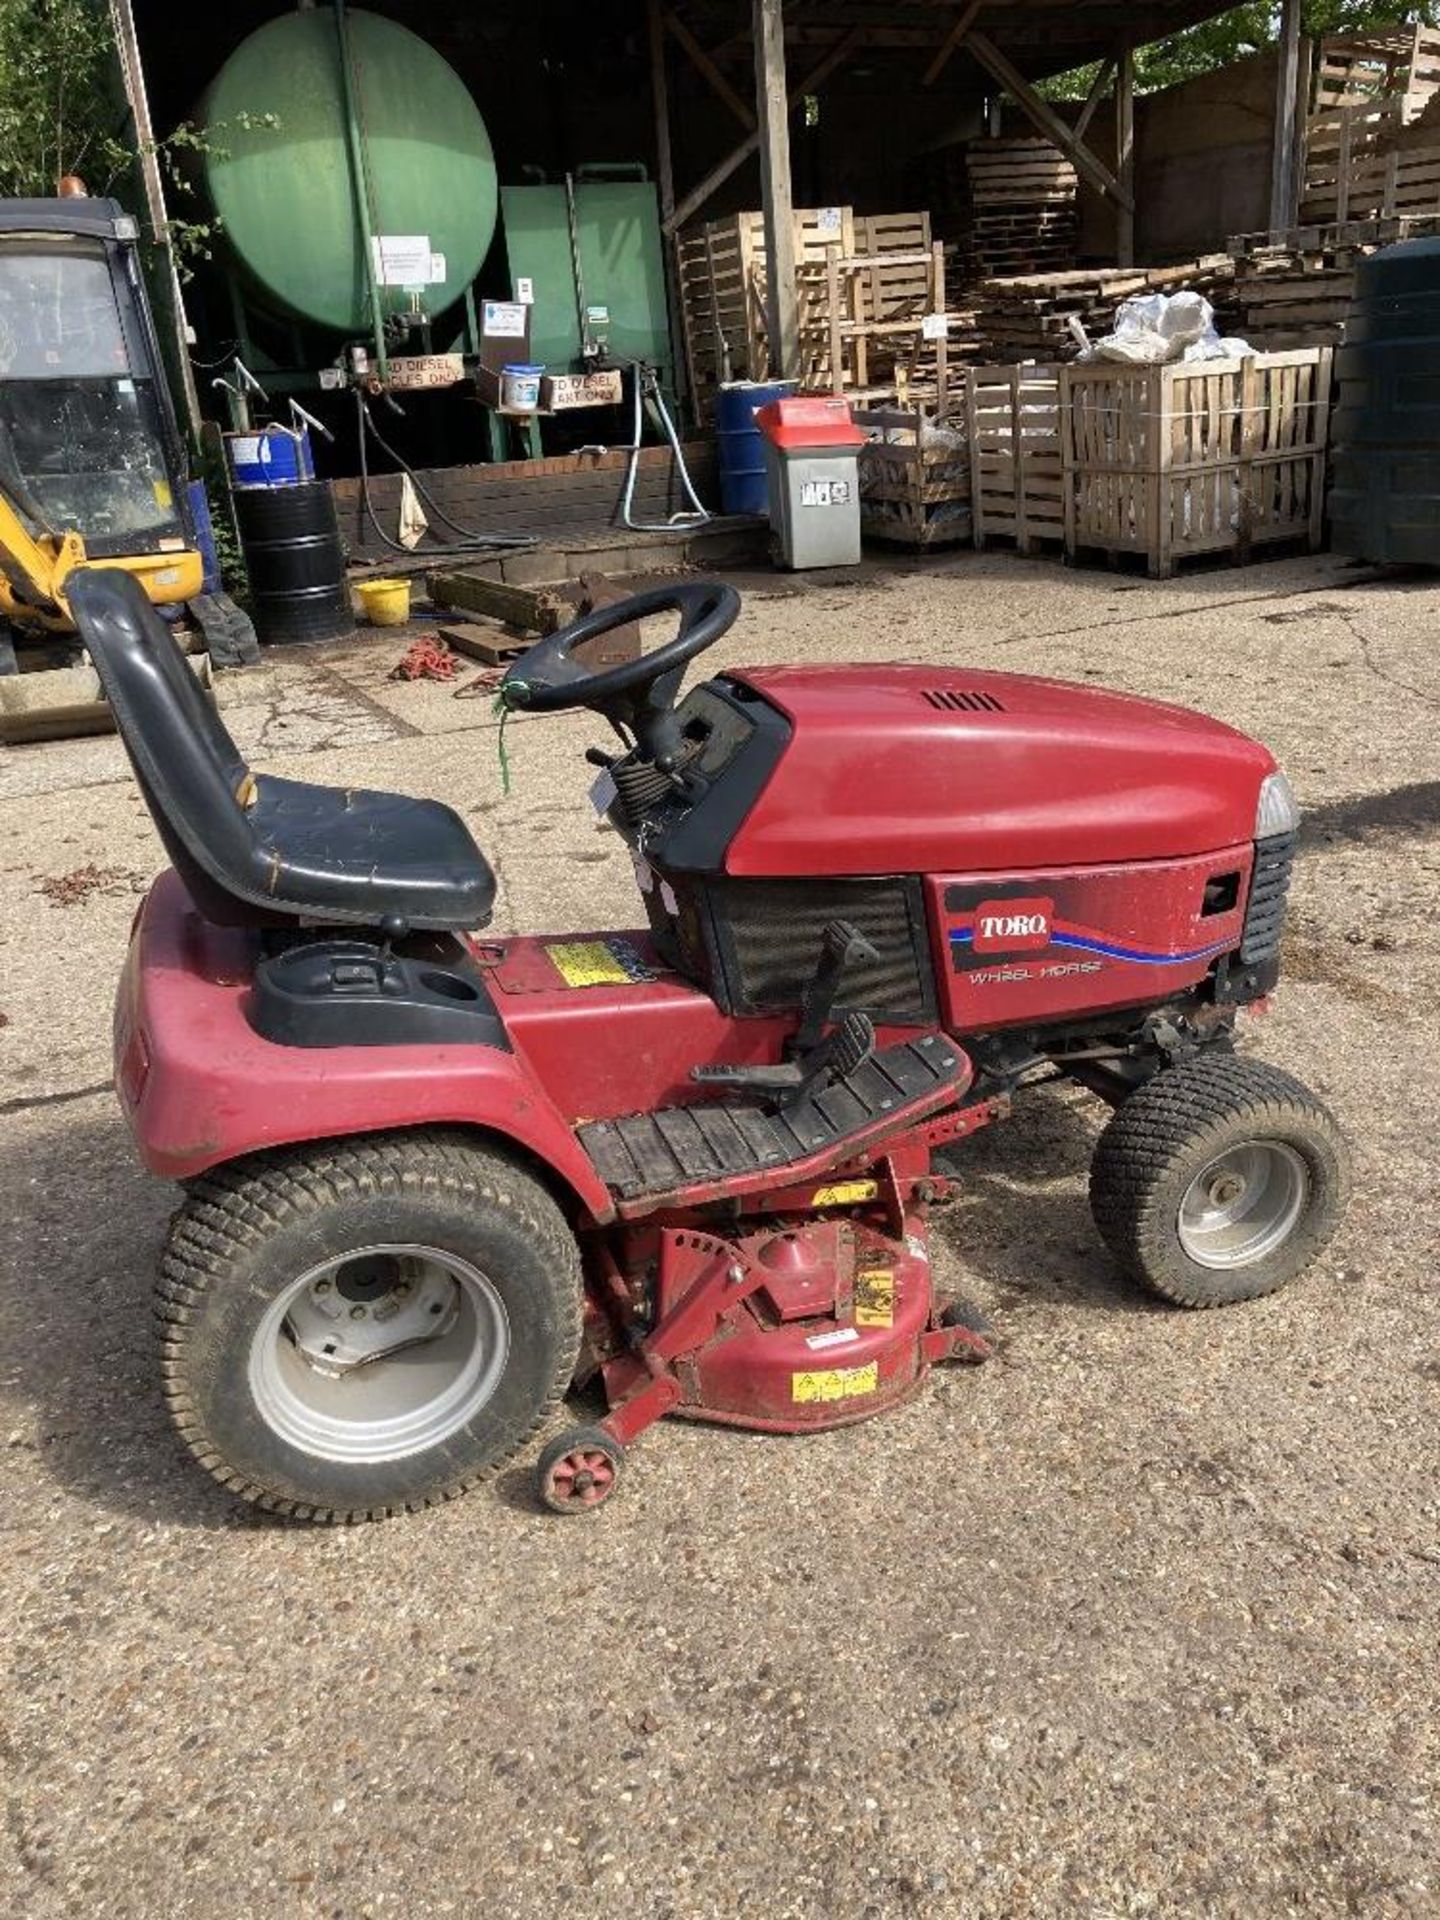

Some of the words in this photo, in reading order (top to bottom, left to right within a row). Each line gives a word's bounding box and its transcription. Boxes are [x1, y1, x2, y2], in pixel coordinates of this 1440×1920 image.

[407, 359, 451, 371] DIESEL
[980, 913, 1046, 938] TORO
[969, 969, 1033, 984] WHEEL
[1040, 961, 1102, 978] HORSE
